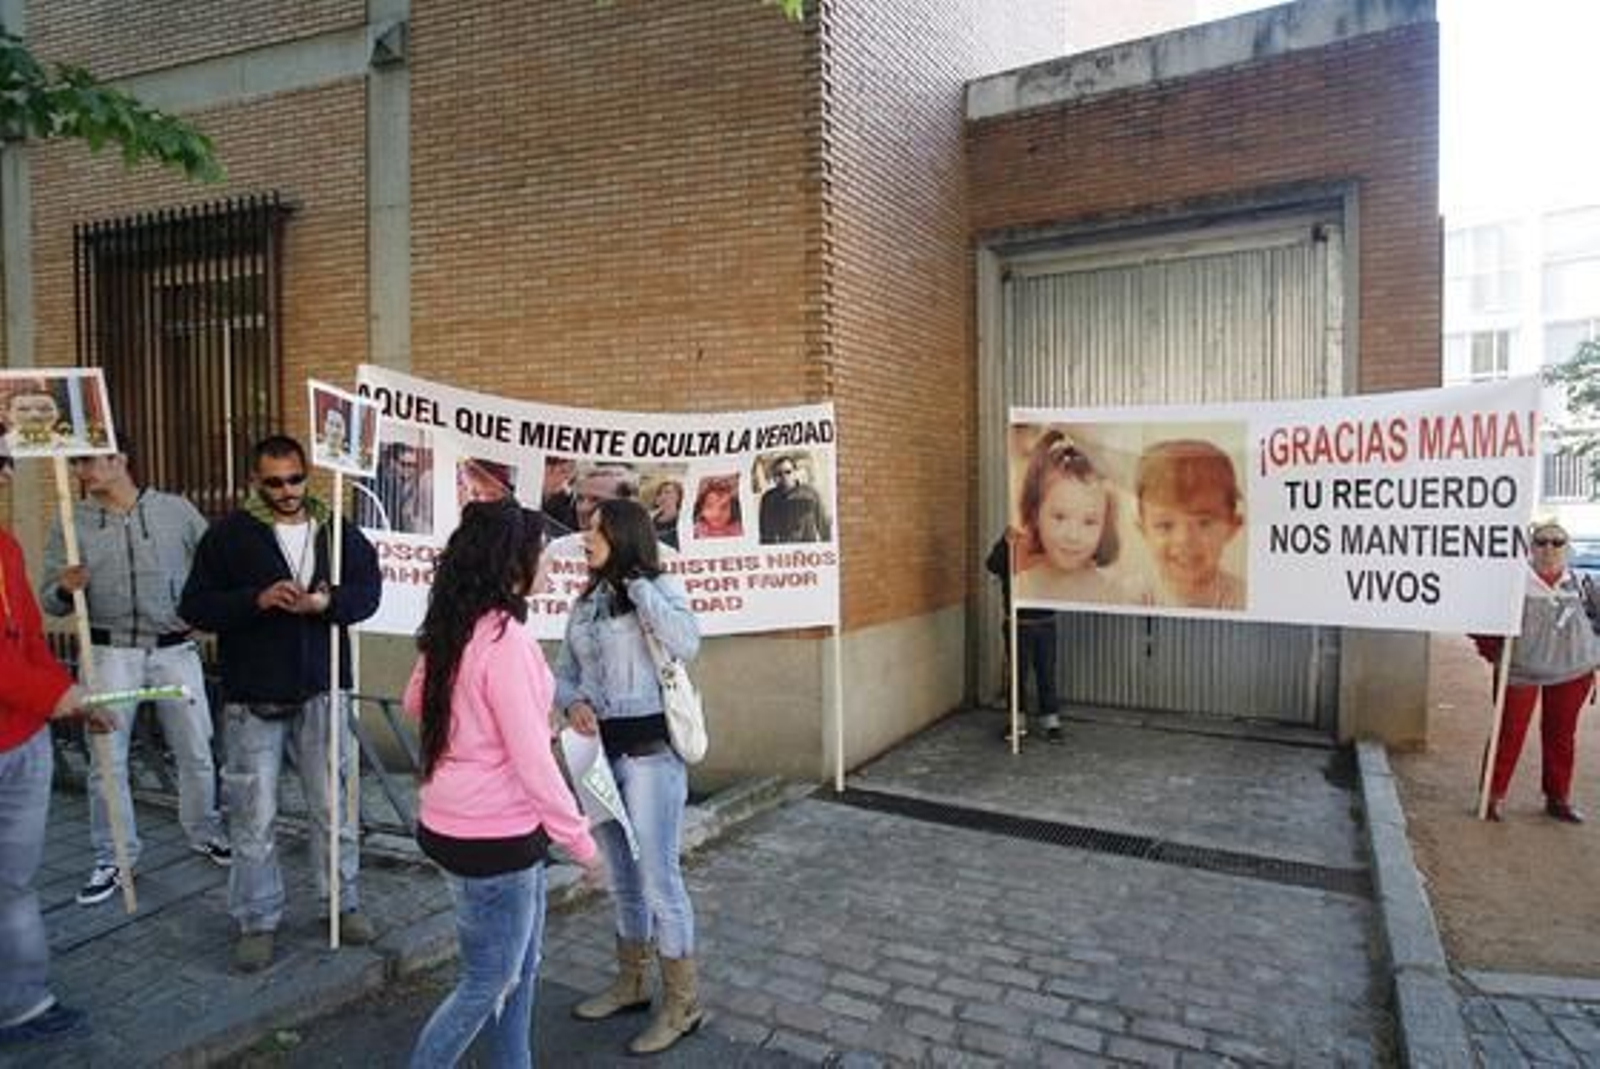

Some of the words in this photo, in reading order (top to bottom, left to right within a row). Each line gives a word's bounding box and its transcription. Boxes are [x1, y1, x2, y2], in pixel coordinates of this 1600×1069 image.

[455, 407, 512, 443] QUE
[519, 421, 626, 457] MIENTE
[632, 430, 720, 458] OCULTA
[724, 429, 750, 454] LA
[755, 419, 834, 449] VERDAD
[1260, 418, 1408, 476] ¡GRACIAS
[1418, 411, 1535, 460] MAMA!
[1285, 480, 1322, 510] TU
[1333, 476, 1517, 510] RECUERDO
[1269, 525, 1331, 554] NOS
[1341, 525, 1529, 558] MANTIENEN
[684, 576, 739, 594] POR
[747, 570, 818, 589] FAVOR
[1347, 570, 1441, 605] VIVOS
